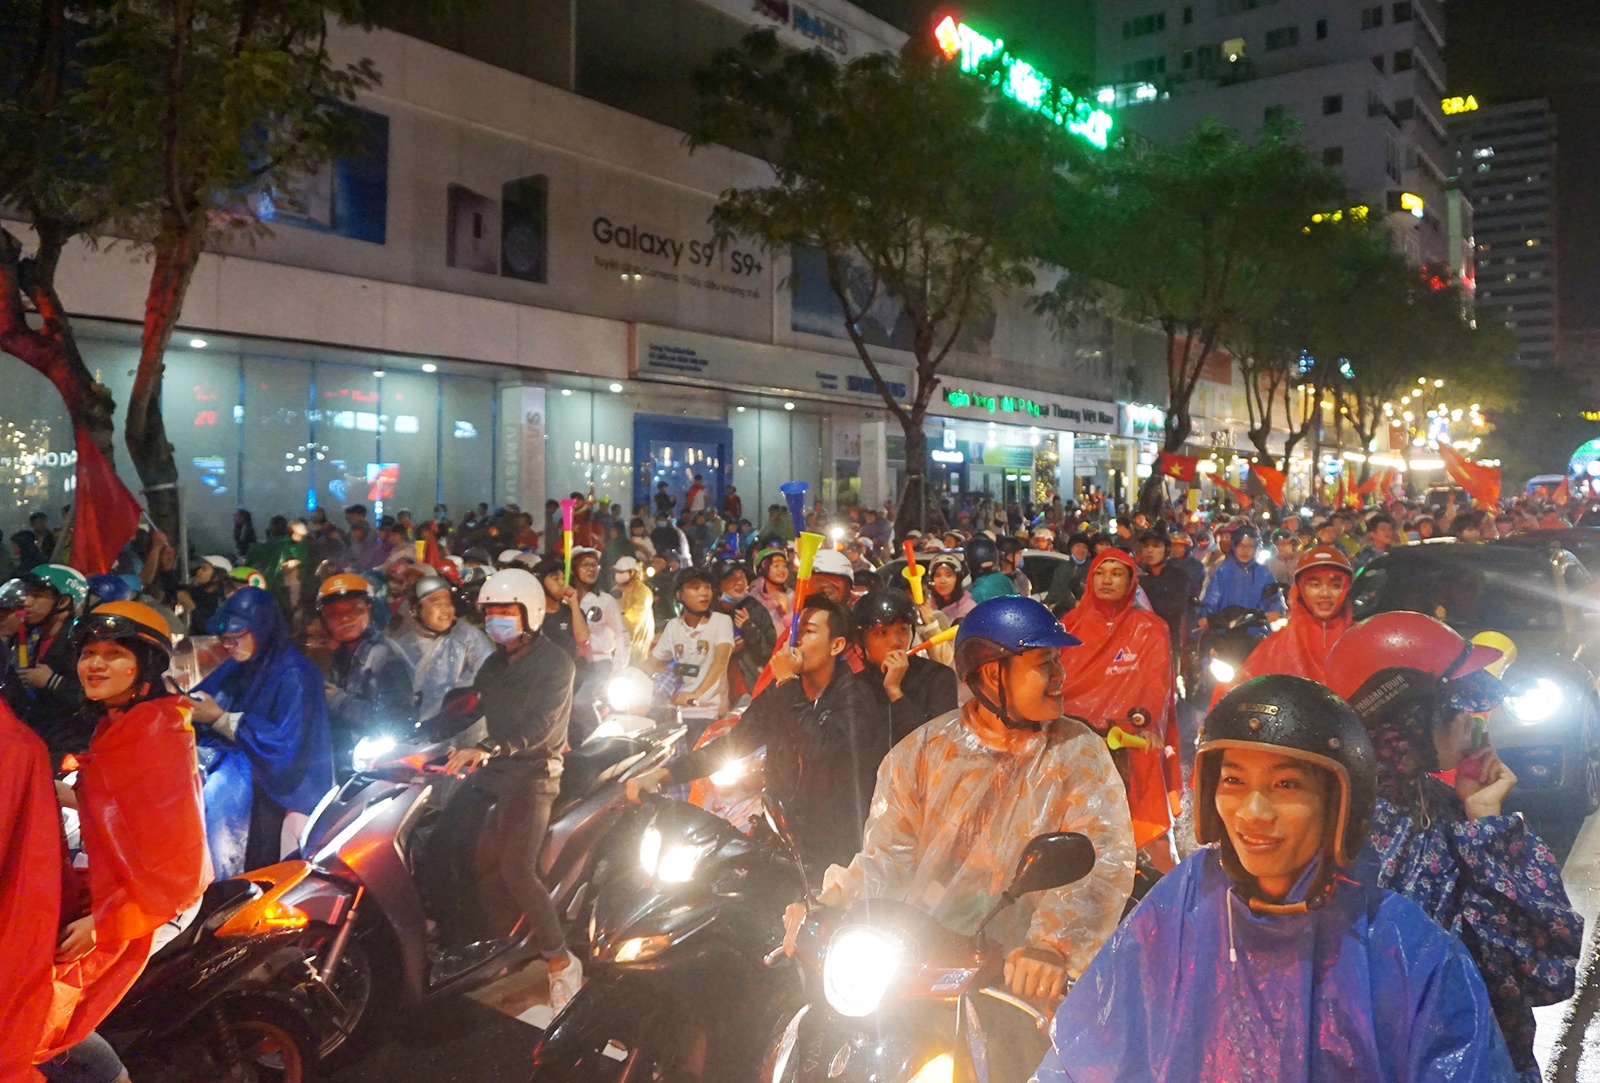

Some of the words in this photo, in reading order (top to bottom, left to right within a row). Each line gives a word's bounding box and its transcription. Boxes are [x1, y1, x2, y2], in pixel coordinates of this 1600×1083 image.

[592, 216, 684, 267] Galaxy
[689, 239, 715, 267] S9
[731, 250, 763, 277] S9+
[1354, 689, 1384, 712] YAMAHA
[1380, 674, 1405, 693] TOWN
